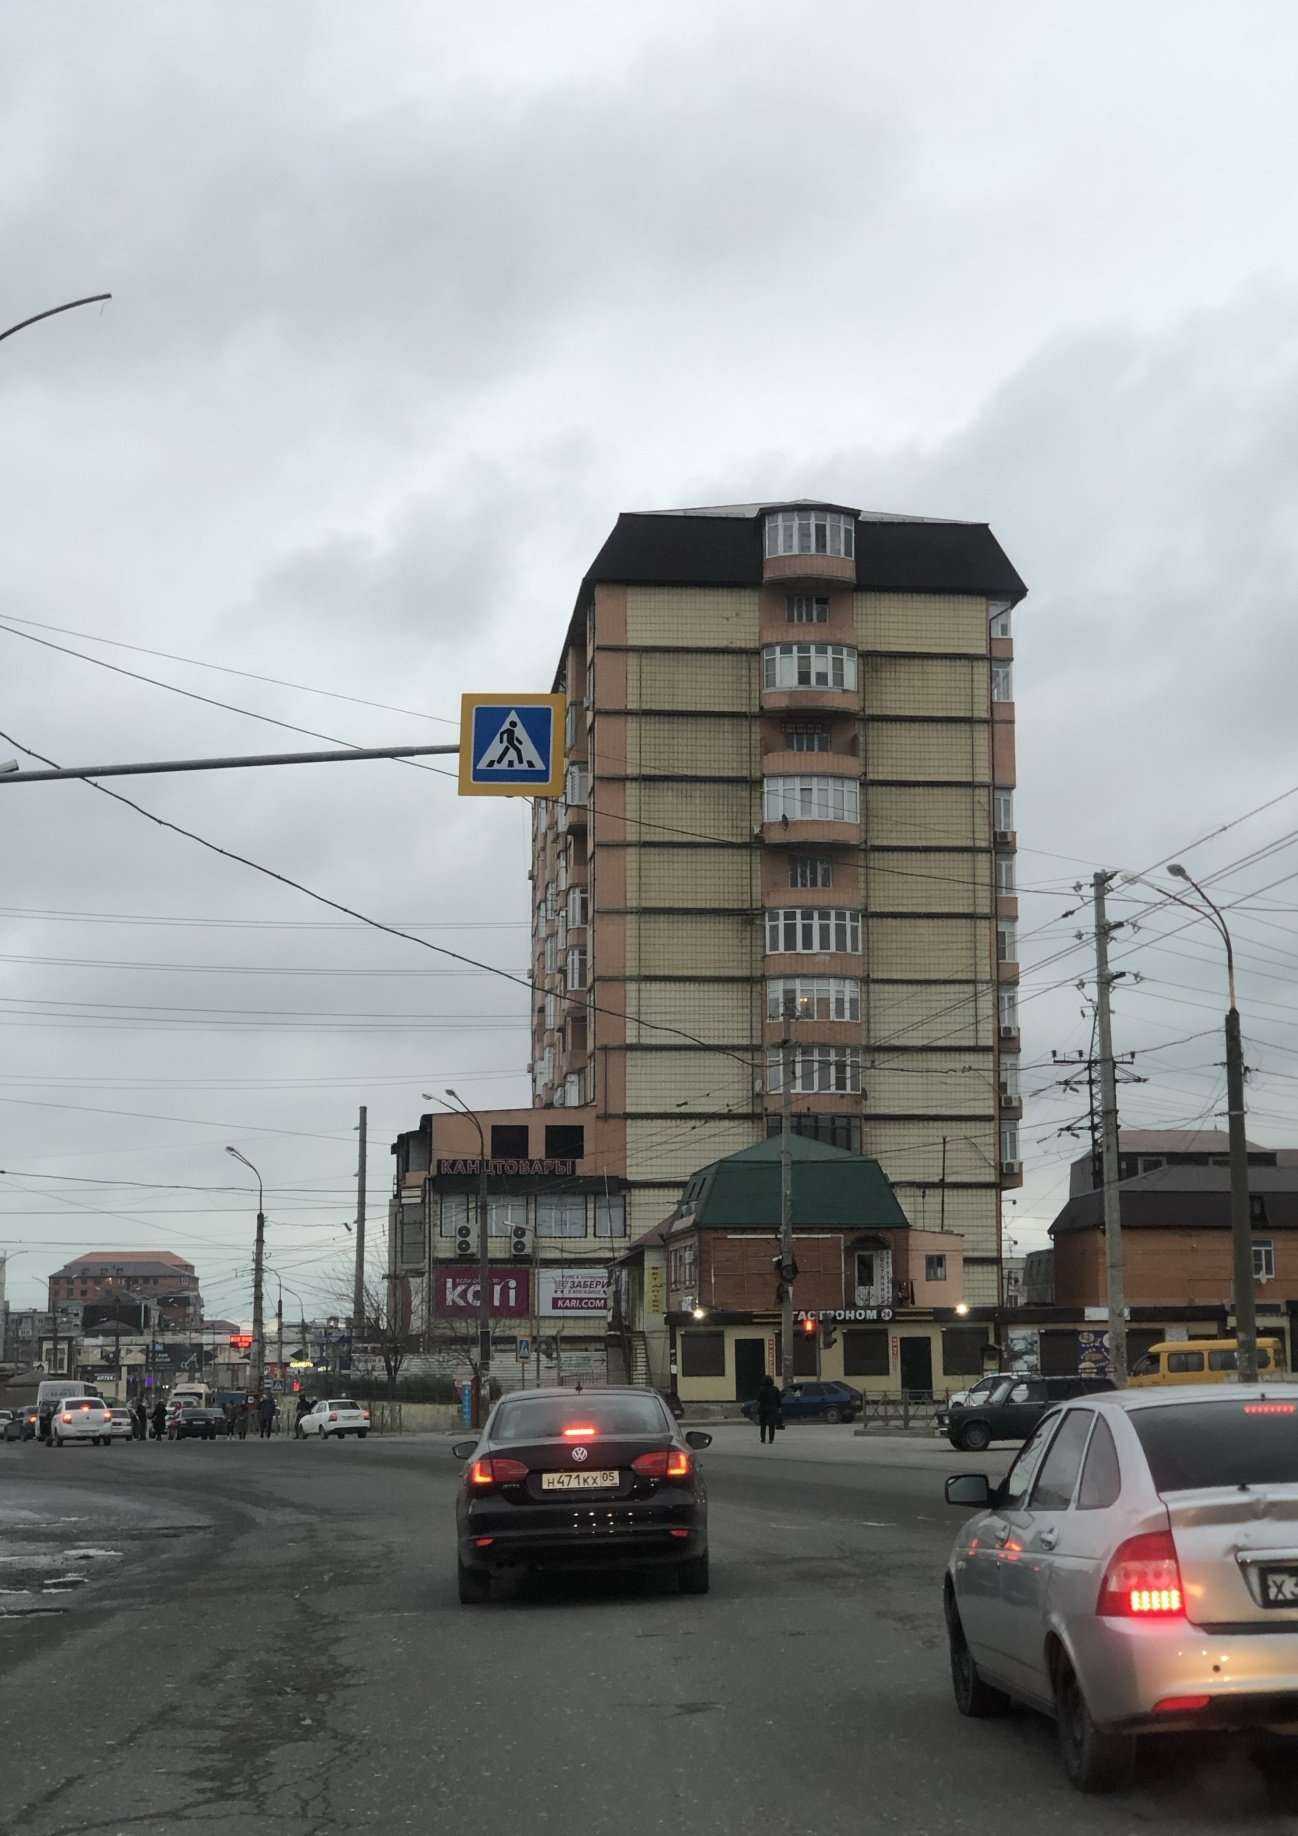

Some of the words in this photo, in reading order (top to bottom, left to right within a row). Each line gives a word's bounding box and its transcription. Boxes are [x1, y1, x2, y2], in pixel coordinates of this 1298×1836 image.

[440, 1159, 573, 1176] КАНЦТОВАРЫ
[569, 1280, 609, 1289] ЗАБЕРИ
[557, 1299, 605, 1308] KARI.COM
[547, 1474, 599, 1488] Н471КХ
[602, 1472, 615, 1482] 05
